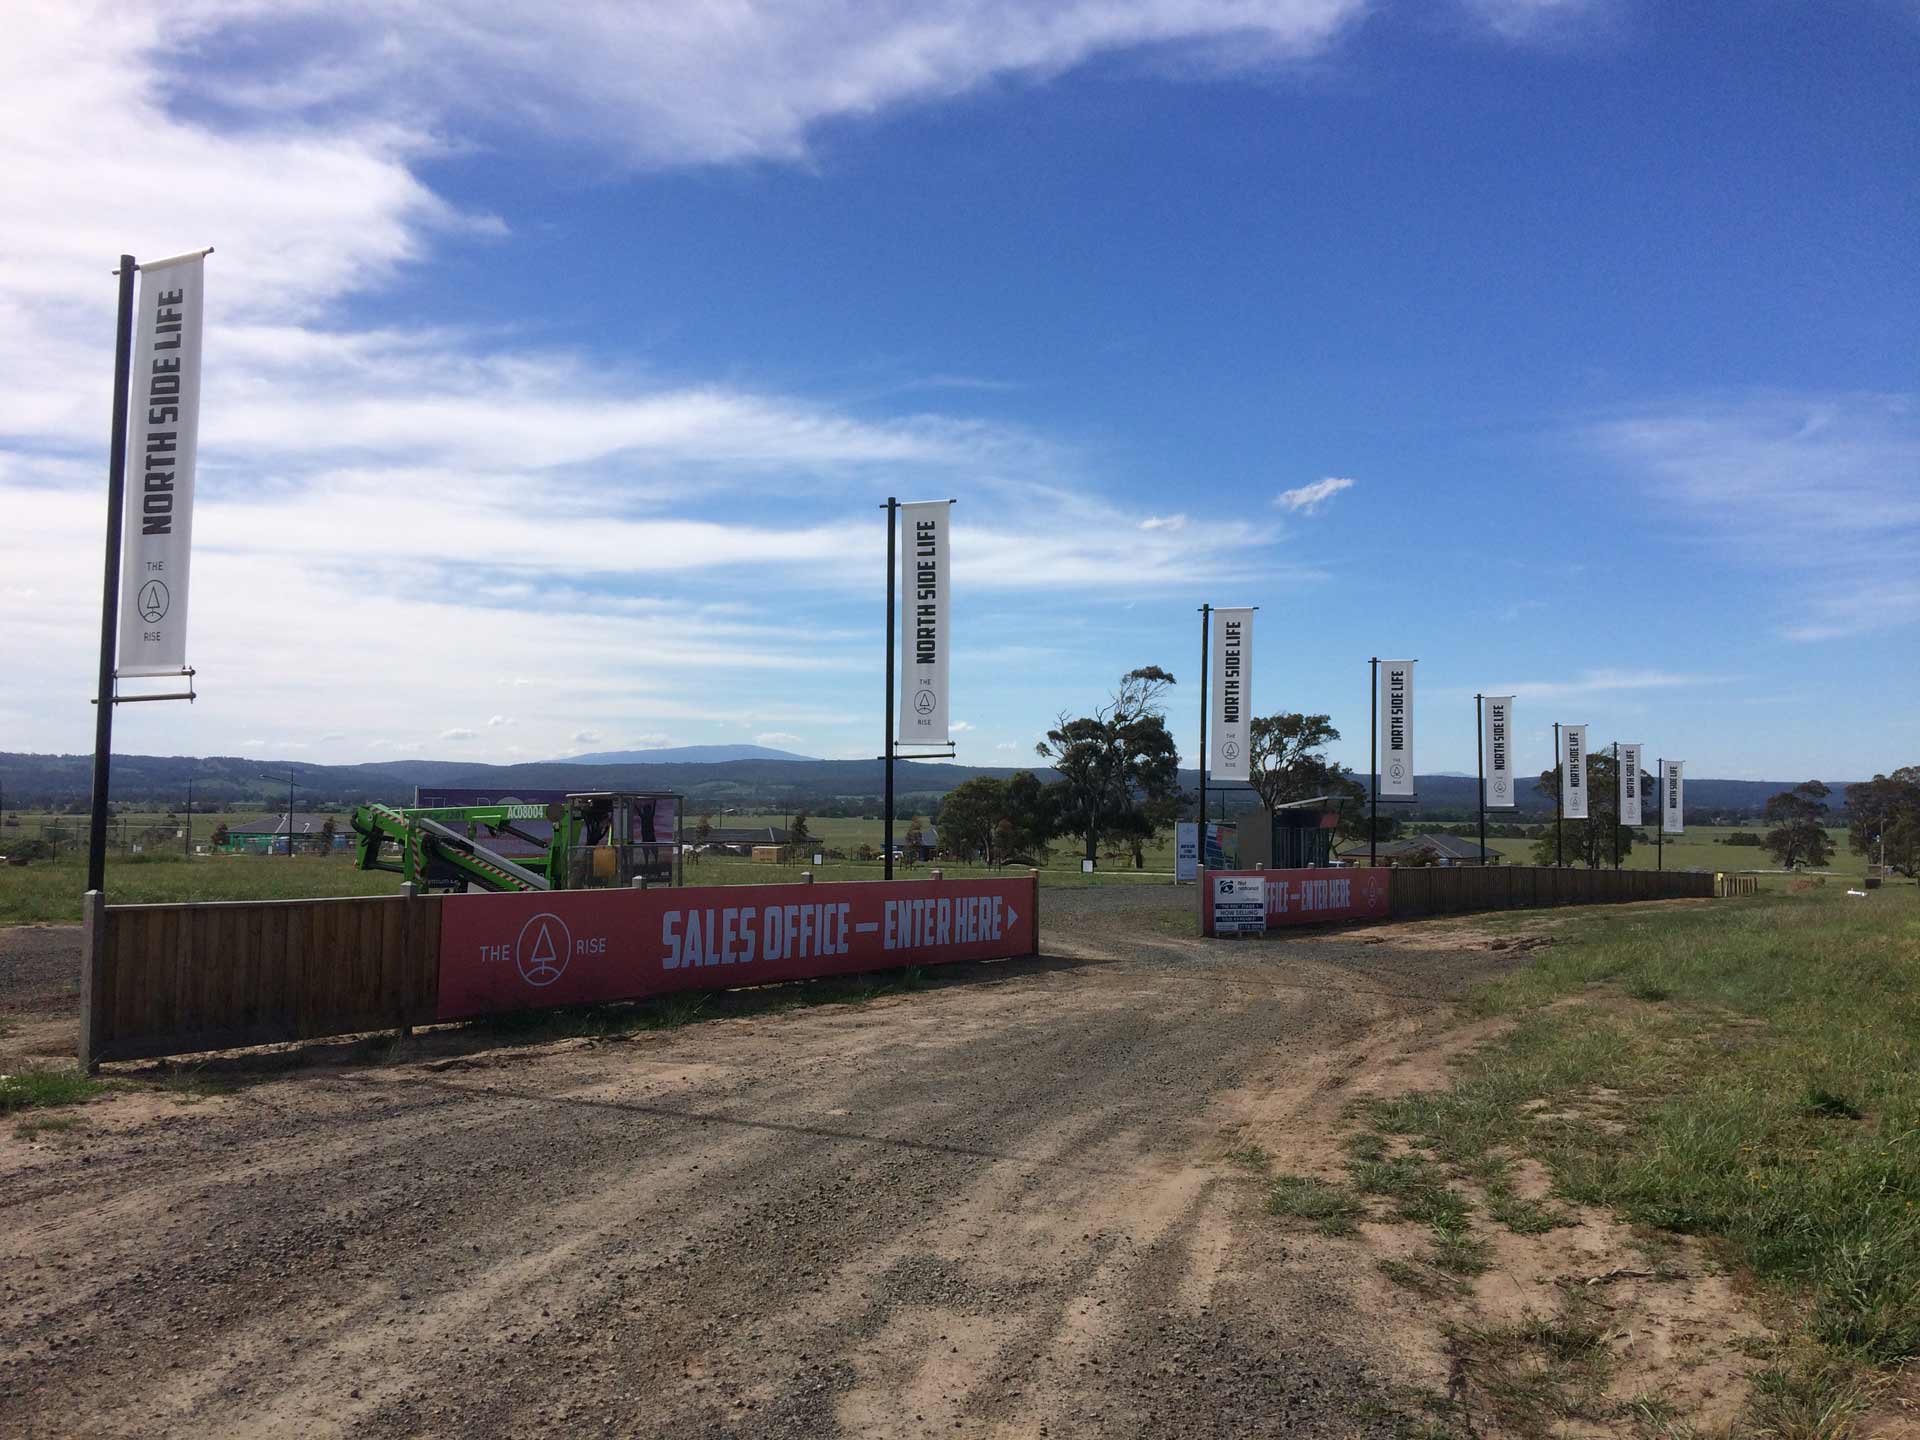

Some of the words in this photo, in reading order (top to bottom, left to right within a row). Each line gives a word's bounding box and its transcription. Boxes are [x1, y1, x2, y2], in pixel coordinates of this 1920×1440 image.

[154, 288, 184, 351] LIFE
[148, 357, 181, 425] SIDE
[142, 432, 177, 535] NORTH
[916, 520, 936, 557] LIFE
[146, 561, 164, 571] THE
[916, 561, 936, 600] SIDE
[143, 632, 161, 642] RISE
[916, 604, 935, 664] NORTH
[1226, 621, 1241, 647] LIFE
[1225, 650, 1241, 678] SIDE
[1391, 671, 1404, 691] LIFE
[1224, 680, 1240, 723] NORTH
[1391, 693, 1404, 715] SIDE
[1493, 705, 1504, 721] LIFE
[1391, 717, 1403, 751] NORTH
[1493, 723, 1505, 741] SIDE
[1569, 733, 1578, 746] LIFE
[1494, 742, 1505, 770] NORTH
[1569, 748, 1579, 763] SIDE
[1570, 764, 1580, 787] NORTH
[662, 906, 757, 970] SALES
[762, 903, 850, 961] OFFICE
[883, 898, 951, 950] ENTER
[955, 896, 1003, 944] HERE
[479, 944, 510, 962] THE
[576, 938, 606, 955] RISE
